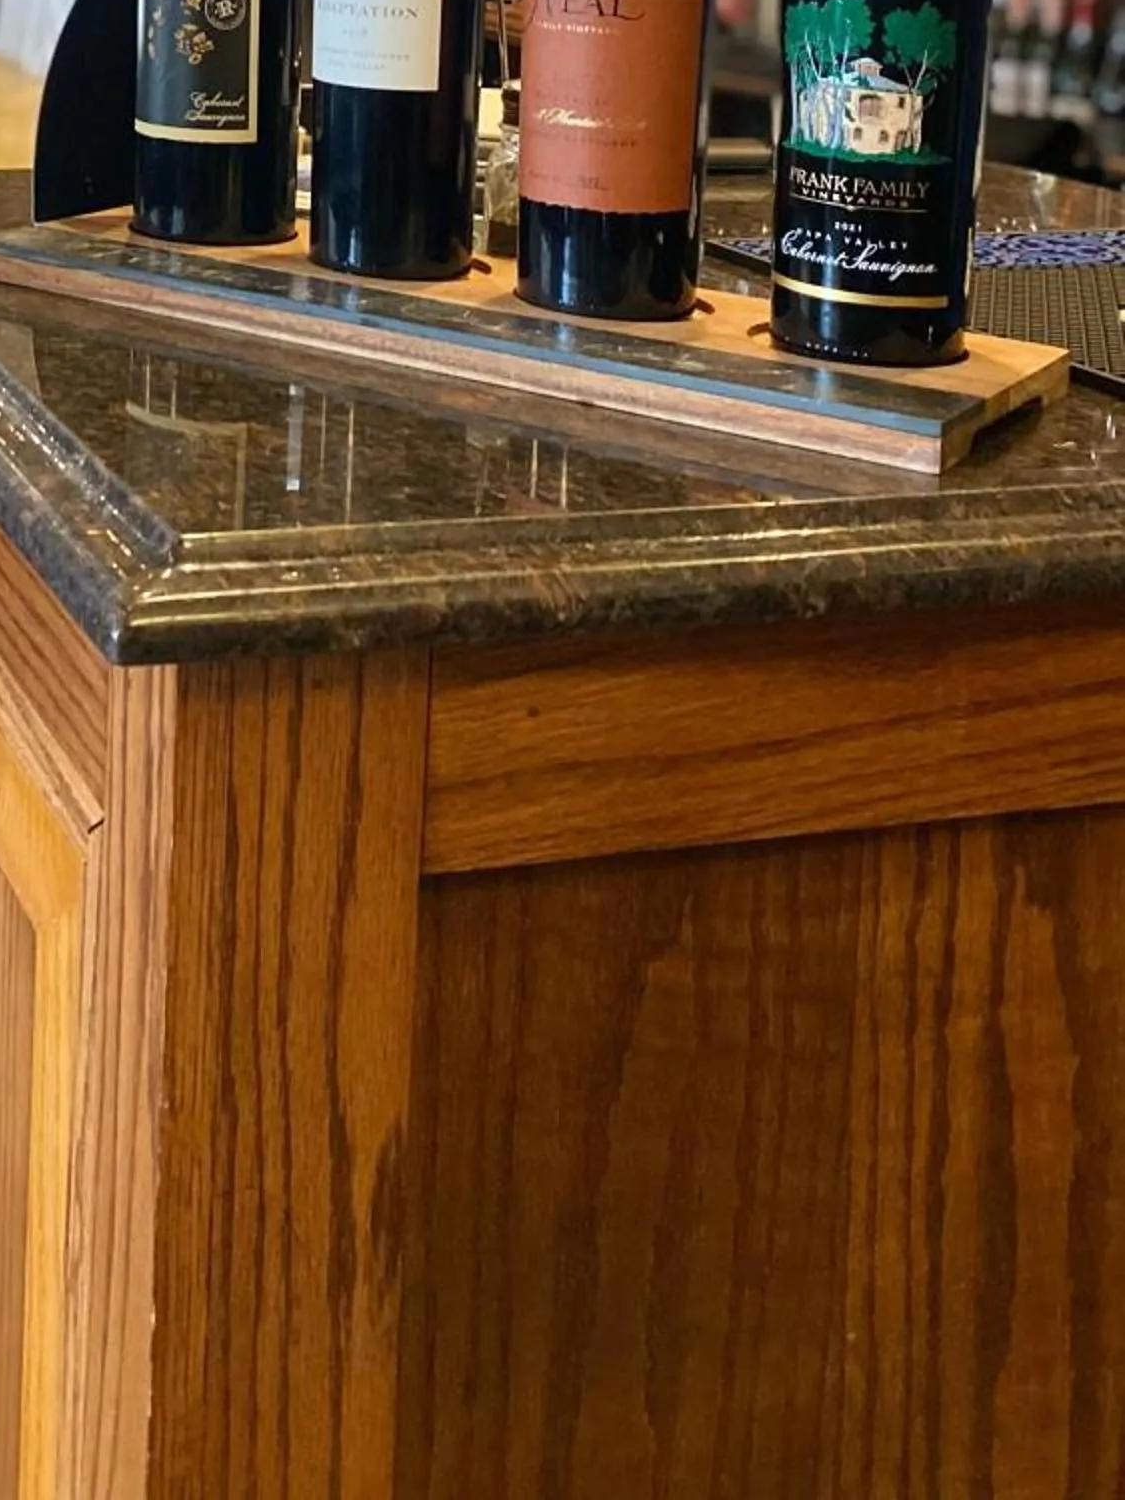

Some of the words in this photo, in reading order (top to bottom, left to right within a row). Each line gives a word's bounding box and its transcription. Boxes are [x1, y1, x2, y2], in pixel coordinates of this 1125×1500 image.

[789, 165, 850, 193] FRANK
[853, 177, 931, 199] FAMILY
[801, 187, 909, 208] VINEYARDS
[780, 229, 849, 267] Cabernet
[841, 243, 937, 281] Sauvignon
